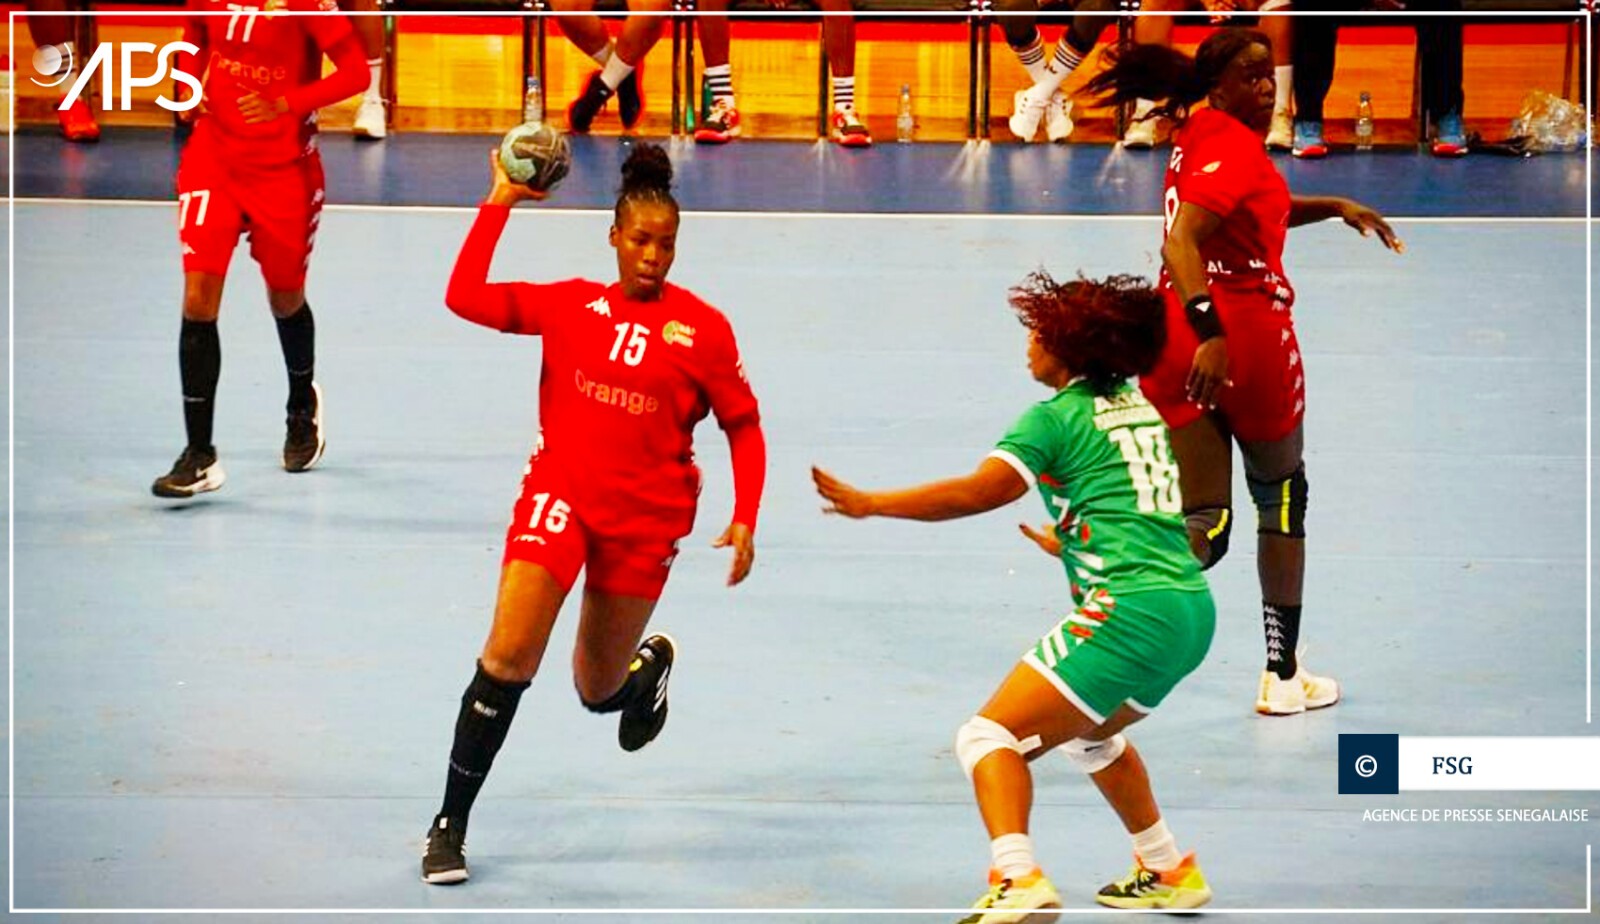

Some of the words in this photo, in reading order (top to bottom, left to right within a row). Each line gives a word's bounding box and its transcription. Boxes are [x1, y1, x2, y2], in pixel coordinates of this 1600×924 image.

[226, 3, 259, 43] 77
[608, 322, 651, 366] 15
[575, 368, 659, 415] Orange
[528, 492, 571, 534] 15
